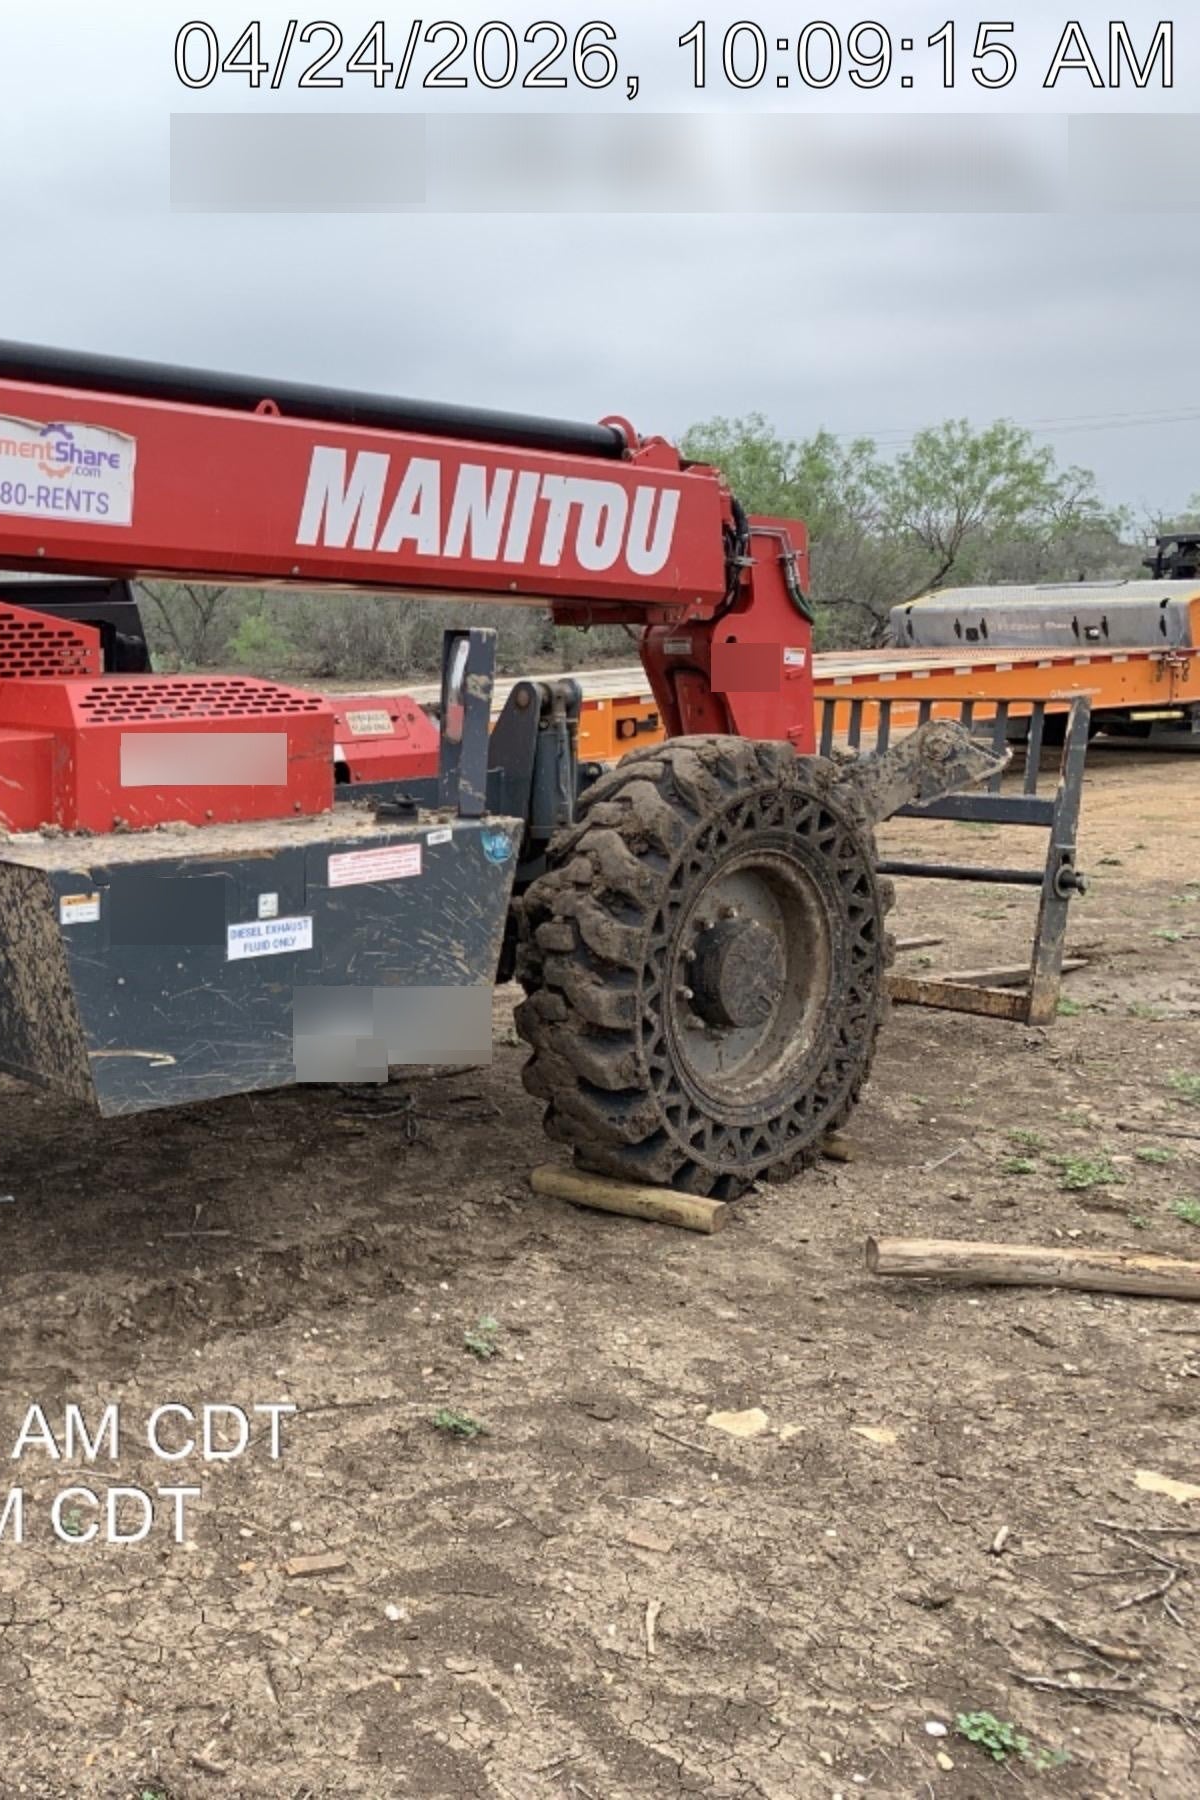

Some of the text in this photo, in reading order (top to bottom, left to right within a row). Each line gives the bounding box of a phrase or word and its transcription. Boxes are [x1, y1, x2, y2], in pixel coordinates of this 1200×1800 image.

[72, 465, 101, 479] .com
[0, 481, 110, 515] 80-RENTS
[296, 446, 681, 576] MANITOU
[230, 919, 309, 940] DIESEL EXHAUST
[243, 936, 297, 953] FLUID ONLY
